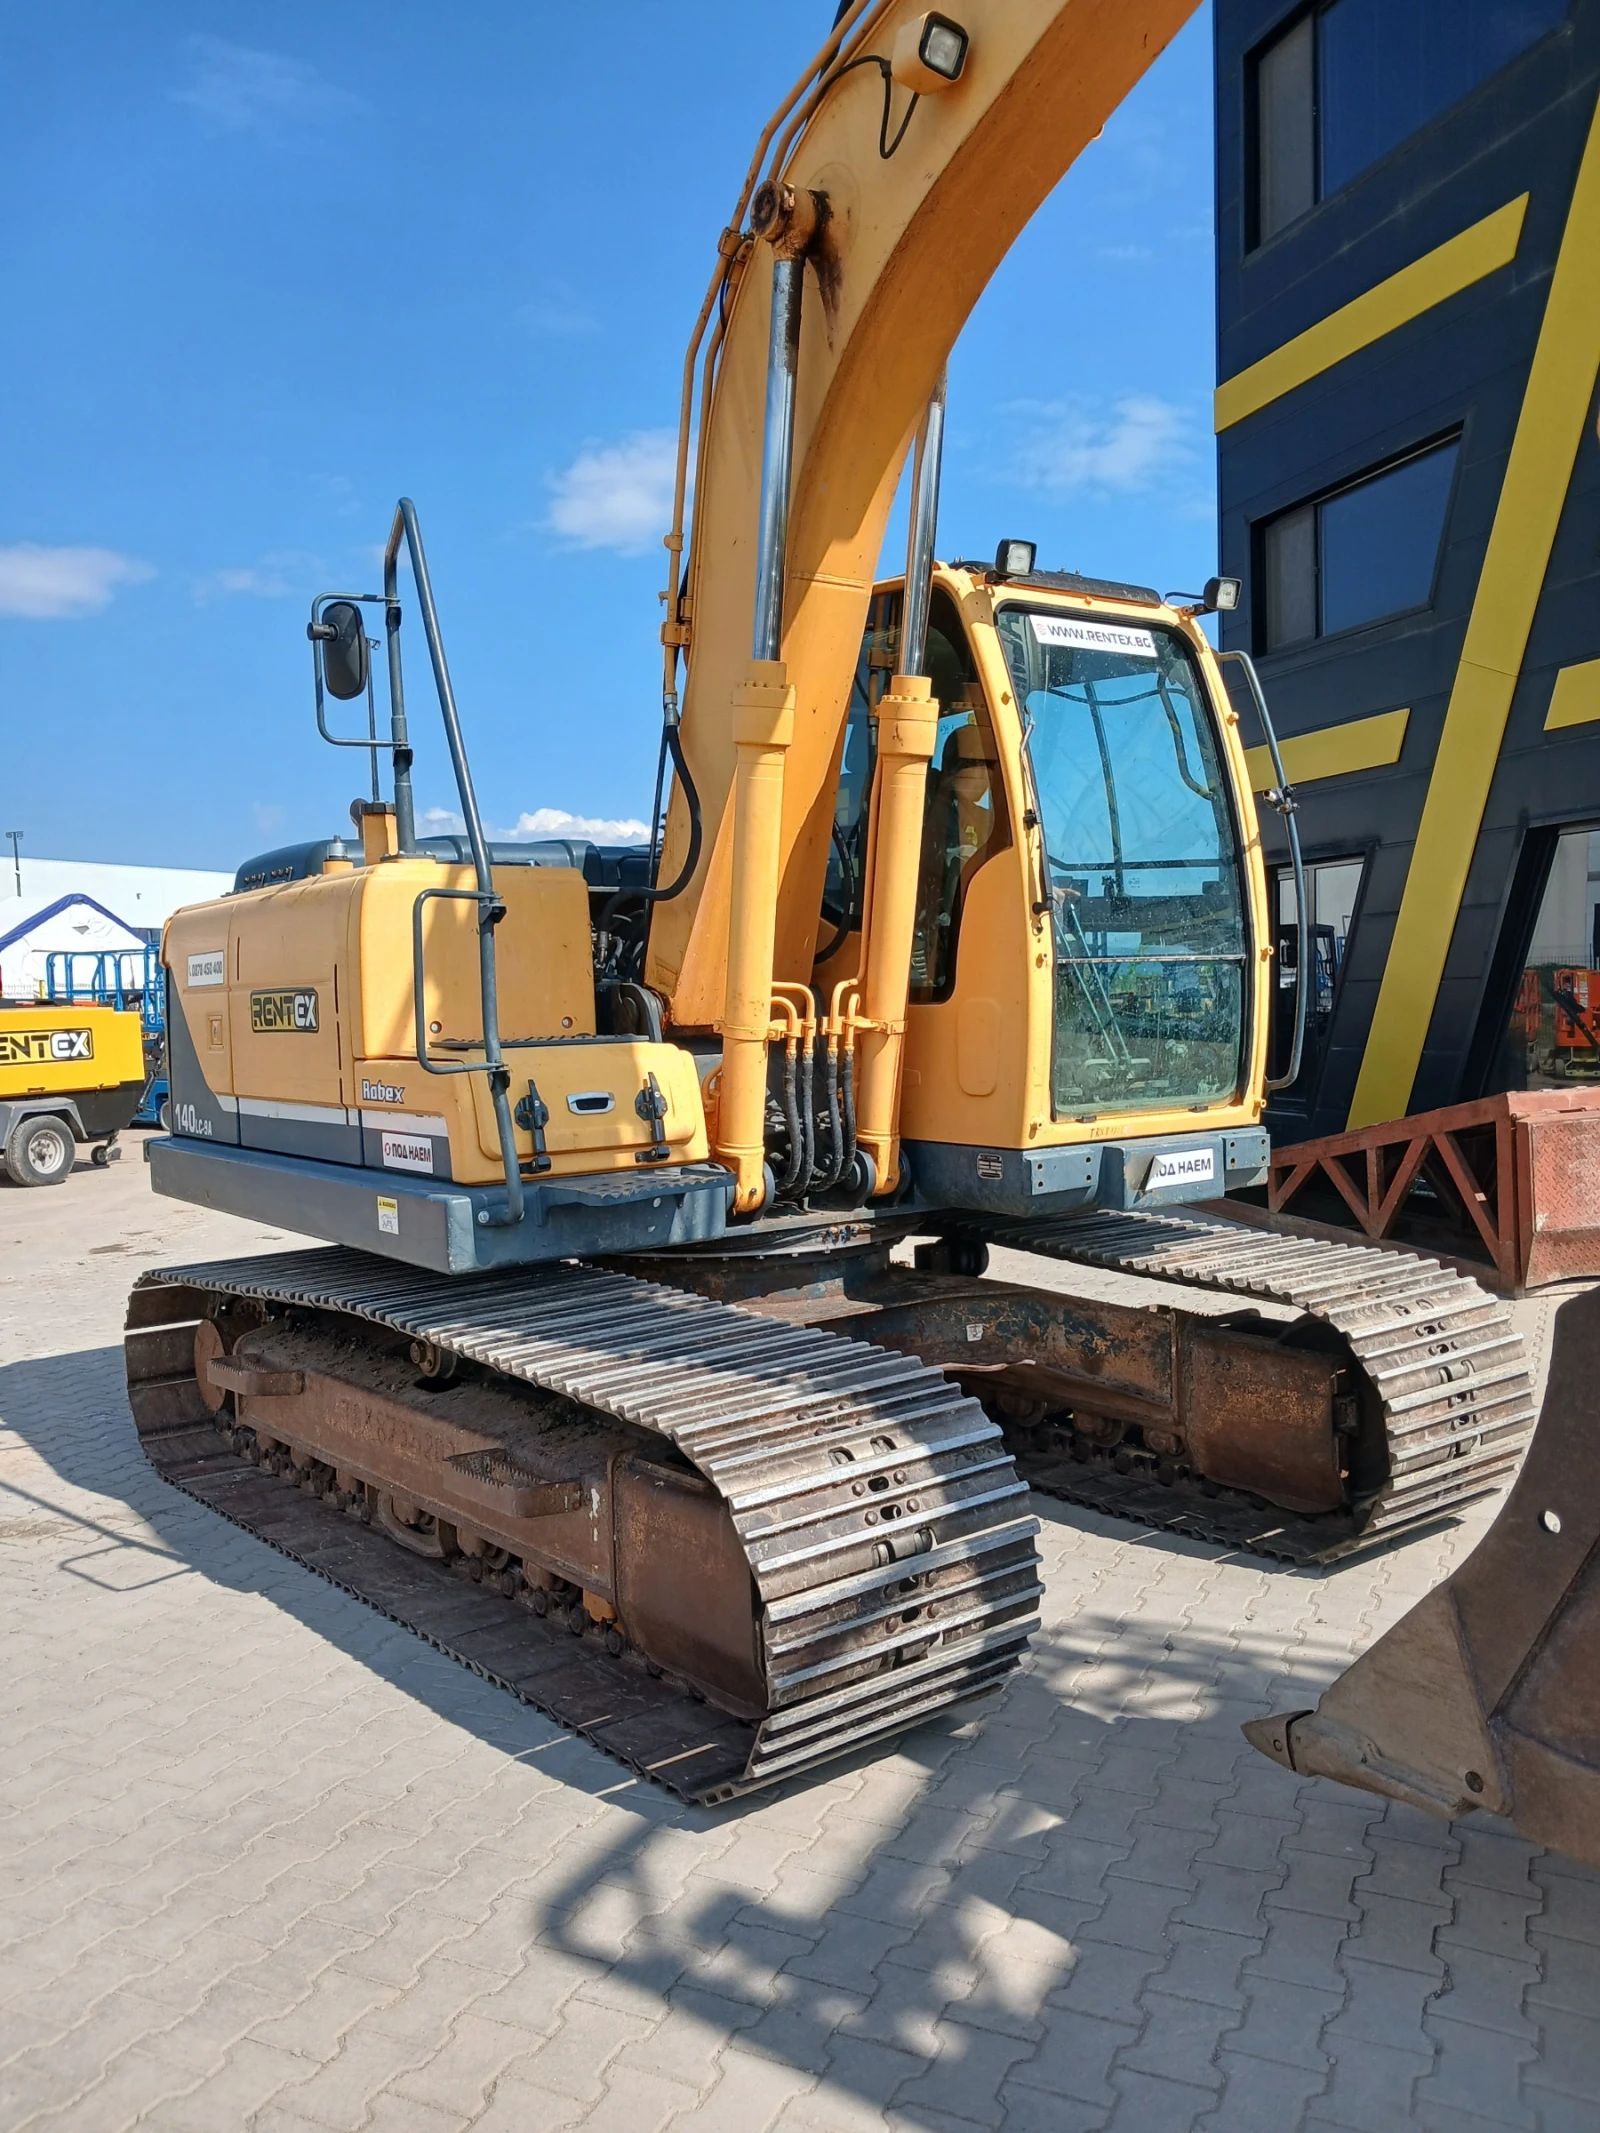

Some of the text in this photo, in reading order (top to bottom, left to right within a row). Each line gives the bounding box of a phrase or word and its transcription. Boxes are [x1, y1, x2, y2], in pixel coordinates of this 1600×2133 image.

[1047, 624, 1151, 648] WWW.RENTEX.BG
[252, 994, 317, 1027] RENTEX
[362, 1079, 405, 1104] Robex
[392, 1143, 431, 1162] ПОД НАЕМ
[1155, 1158, 1212, 1177] ОД НАЕМ
